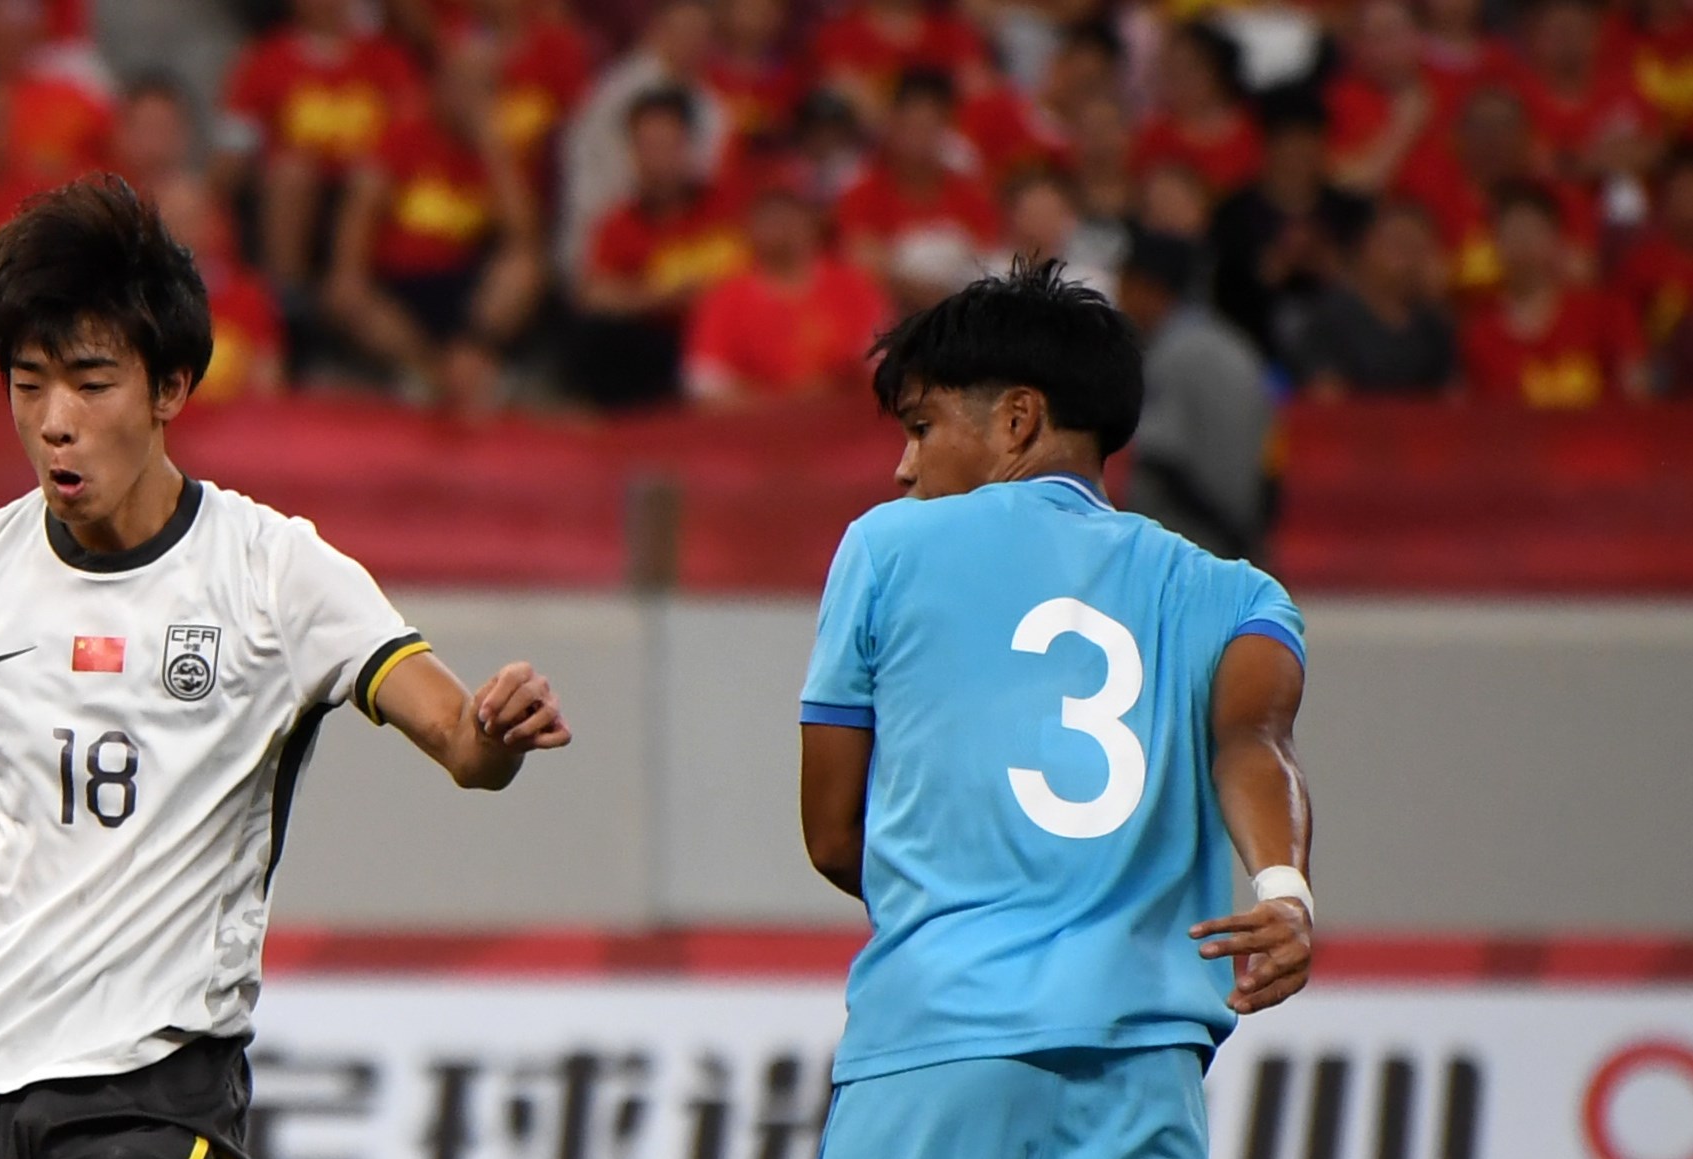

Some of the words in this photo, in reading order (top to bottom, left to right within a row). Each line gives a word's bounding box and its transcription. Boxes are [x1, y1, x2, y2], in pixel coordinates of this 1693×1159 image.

[171, 629, 216, 644] CFA
[1007, 597, 1146, 838] 3
[52, 728, 140, 828] 18
